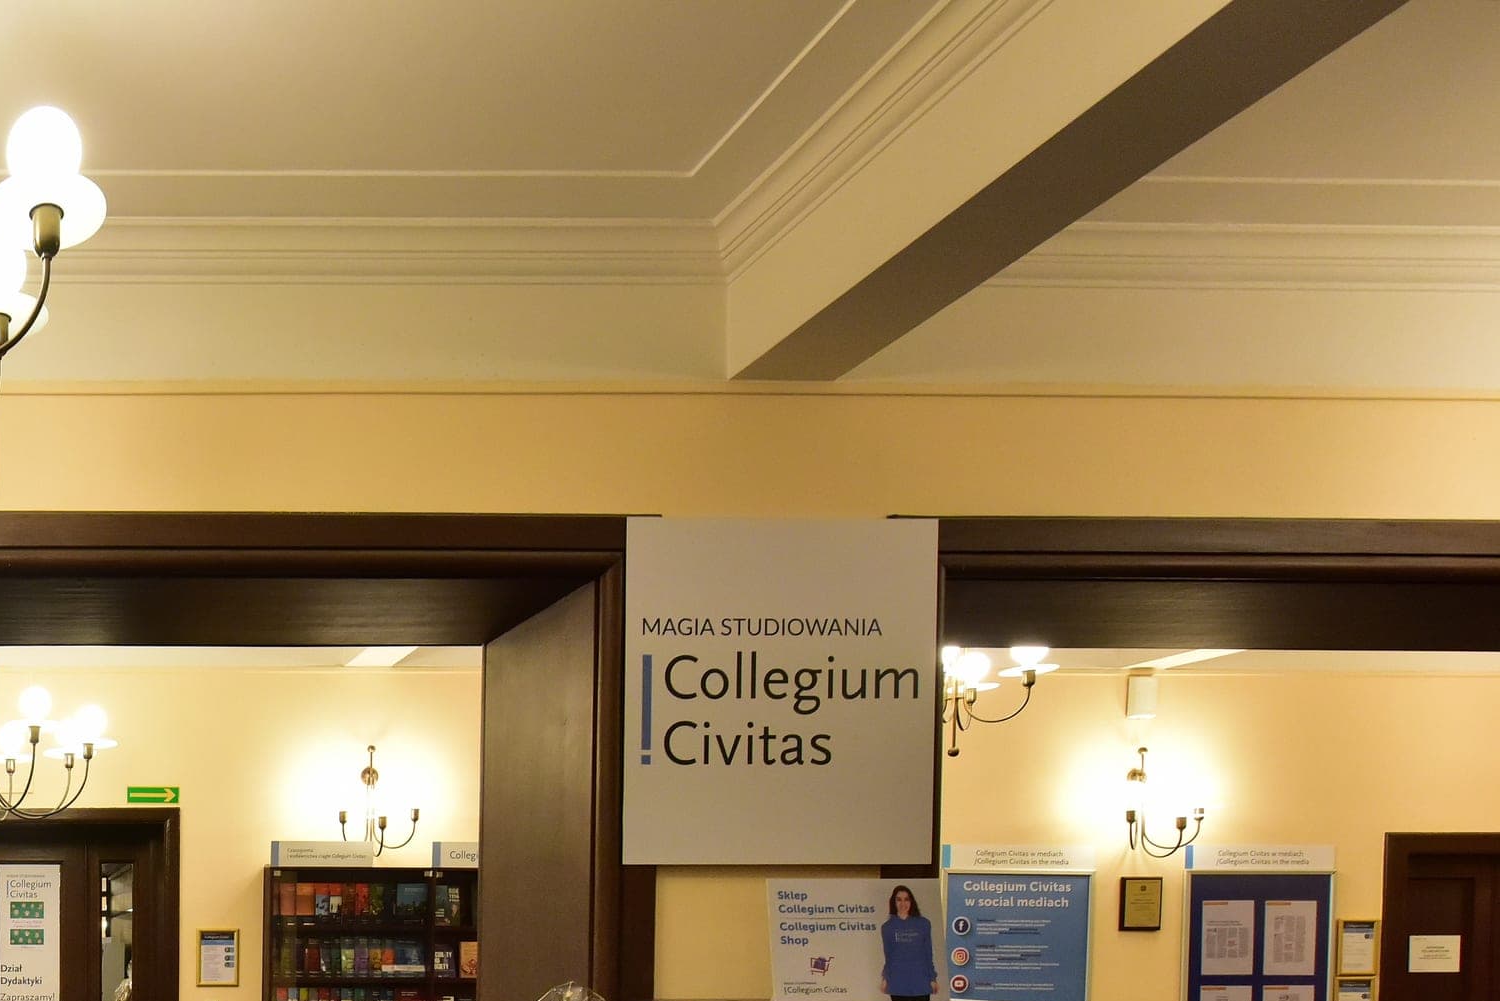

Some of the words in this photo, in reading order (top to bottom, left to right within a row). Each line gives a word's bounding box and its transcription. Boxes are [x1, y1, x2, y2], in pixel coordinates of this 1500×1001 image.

[642, 617, 715, 637] MAGIA
[720, 617, 883, 637] STUDIOWANIA
[664, 651, 919, 715] Collegium
[663, 720, 833, 766] Civitas
[9, 879, 52, 889] Collegium
[963, 880, 1027, 894] Collegium
[1029, 881, 1072, 893] Civitas
[9, 890, 38, 899] Civitas
[777, 890, 808, 902] Sklep
[965, 897, 976, 907] w
[978, 896, 1014, 907] social
[1016, 896, 1069, 908] mediach
[778, 904, 835, 916] Collegium
[837, 904, 876, 914] Civitas
[779, 921, 837, 933] Collegium
[838, 921, 877, 931] Civitas
[780, 935, 809, 947] Shop
[0, 963, 23, 973] Dział
[0, 977, 43, 988] Dydaktyki
